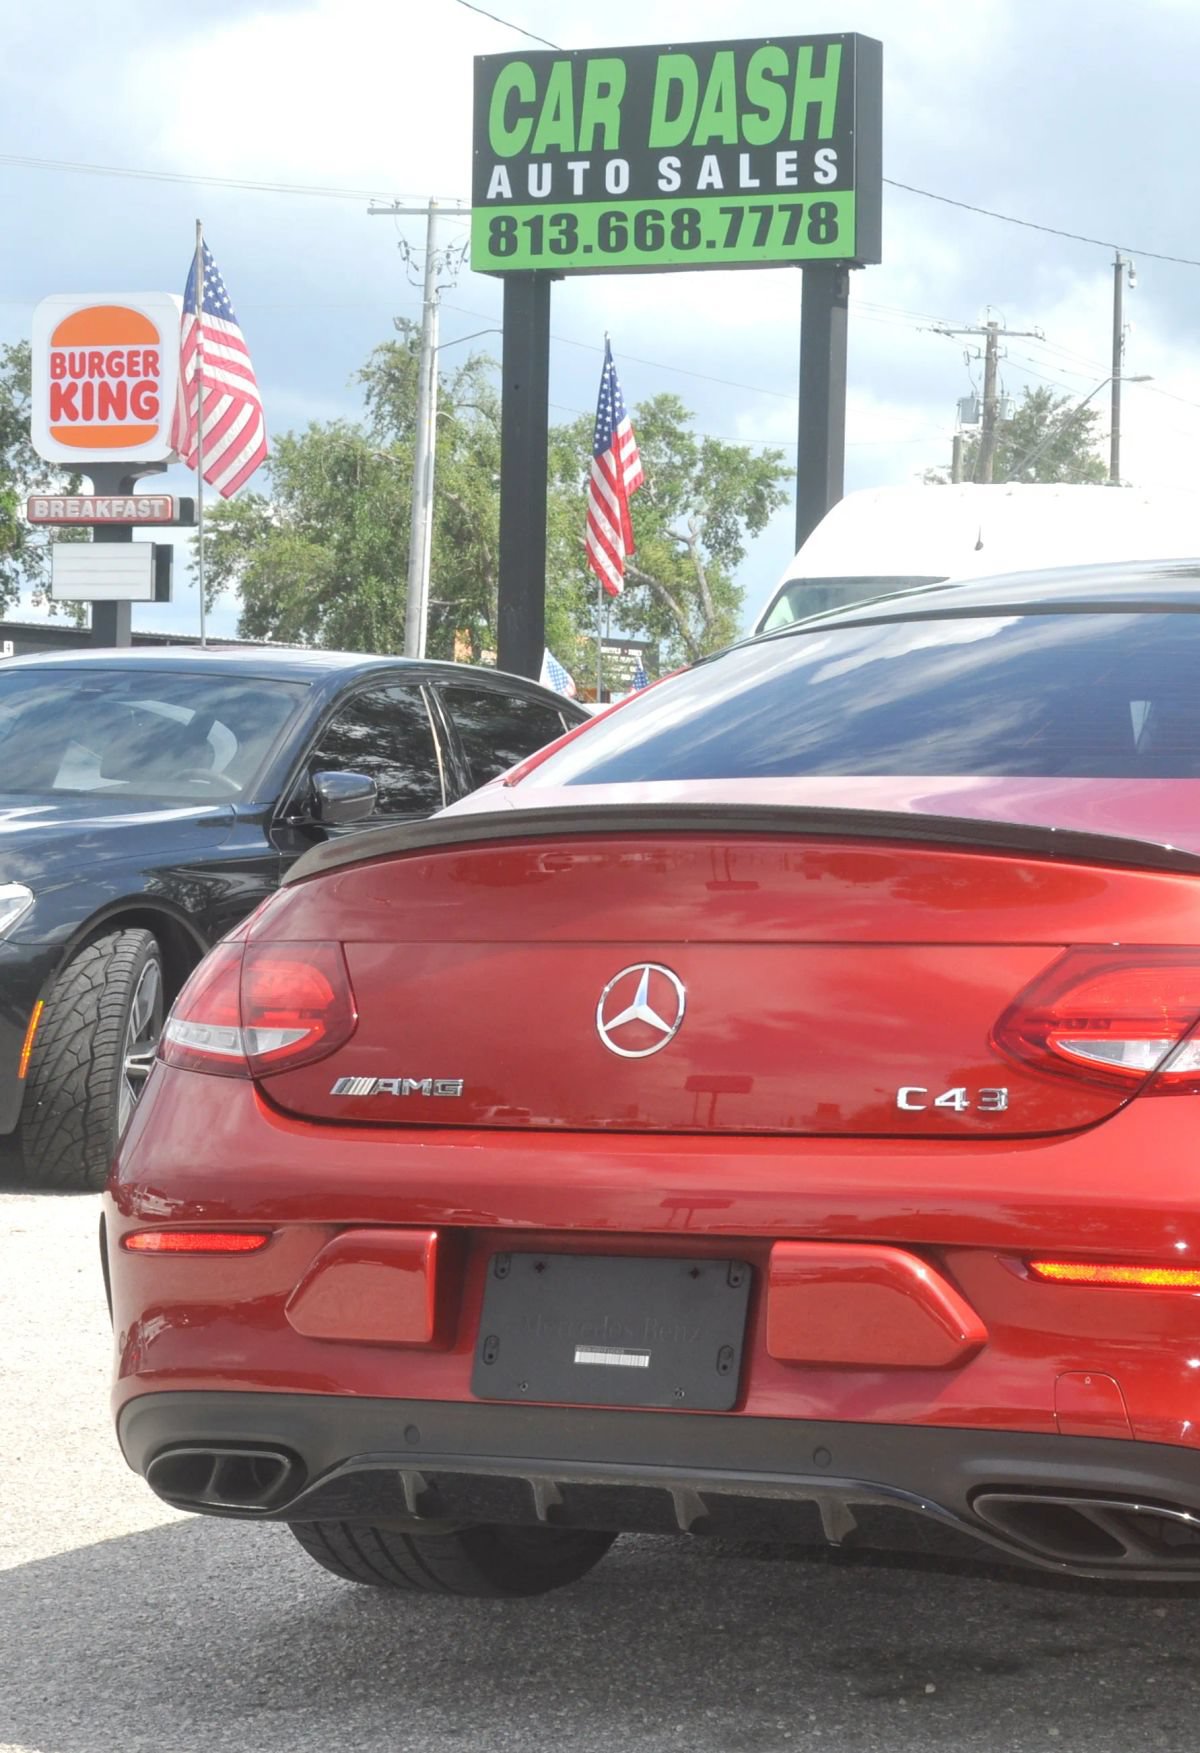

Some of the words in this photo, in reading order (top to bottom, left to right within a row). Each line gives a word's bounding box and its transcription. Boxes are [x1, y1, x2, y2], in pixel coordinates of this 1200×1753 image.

[488, 57, 627, 158] CAR
[648, 43, 843, 149] DASH
[487, 158, 631, 200] AUTO
[657, 148, 838, 192] SALES
[487, 201, 839, 257] 813.668.7778
[50, 349, 160, 380] BURGER
[50, 380, 160, 422] KING
[33, 499, 164, 518] BREAKFAST
[372, 1077, 464, 1097] AMG
